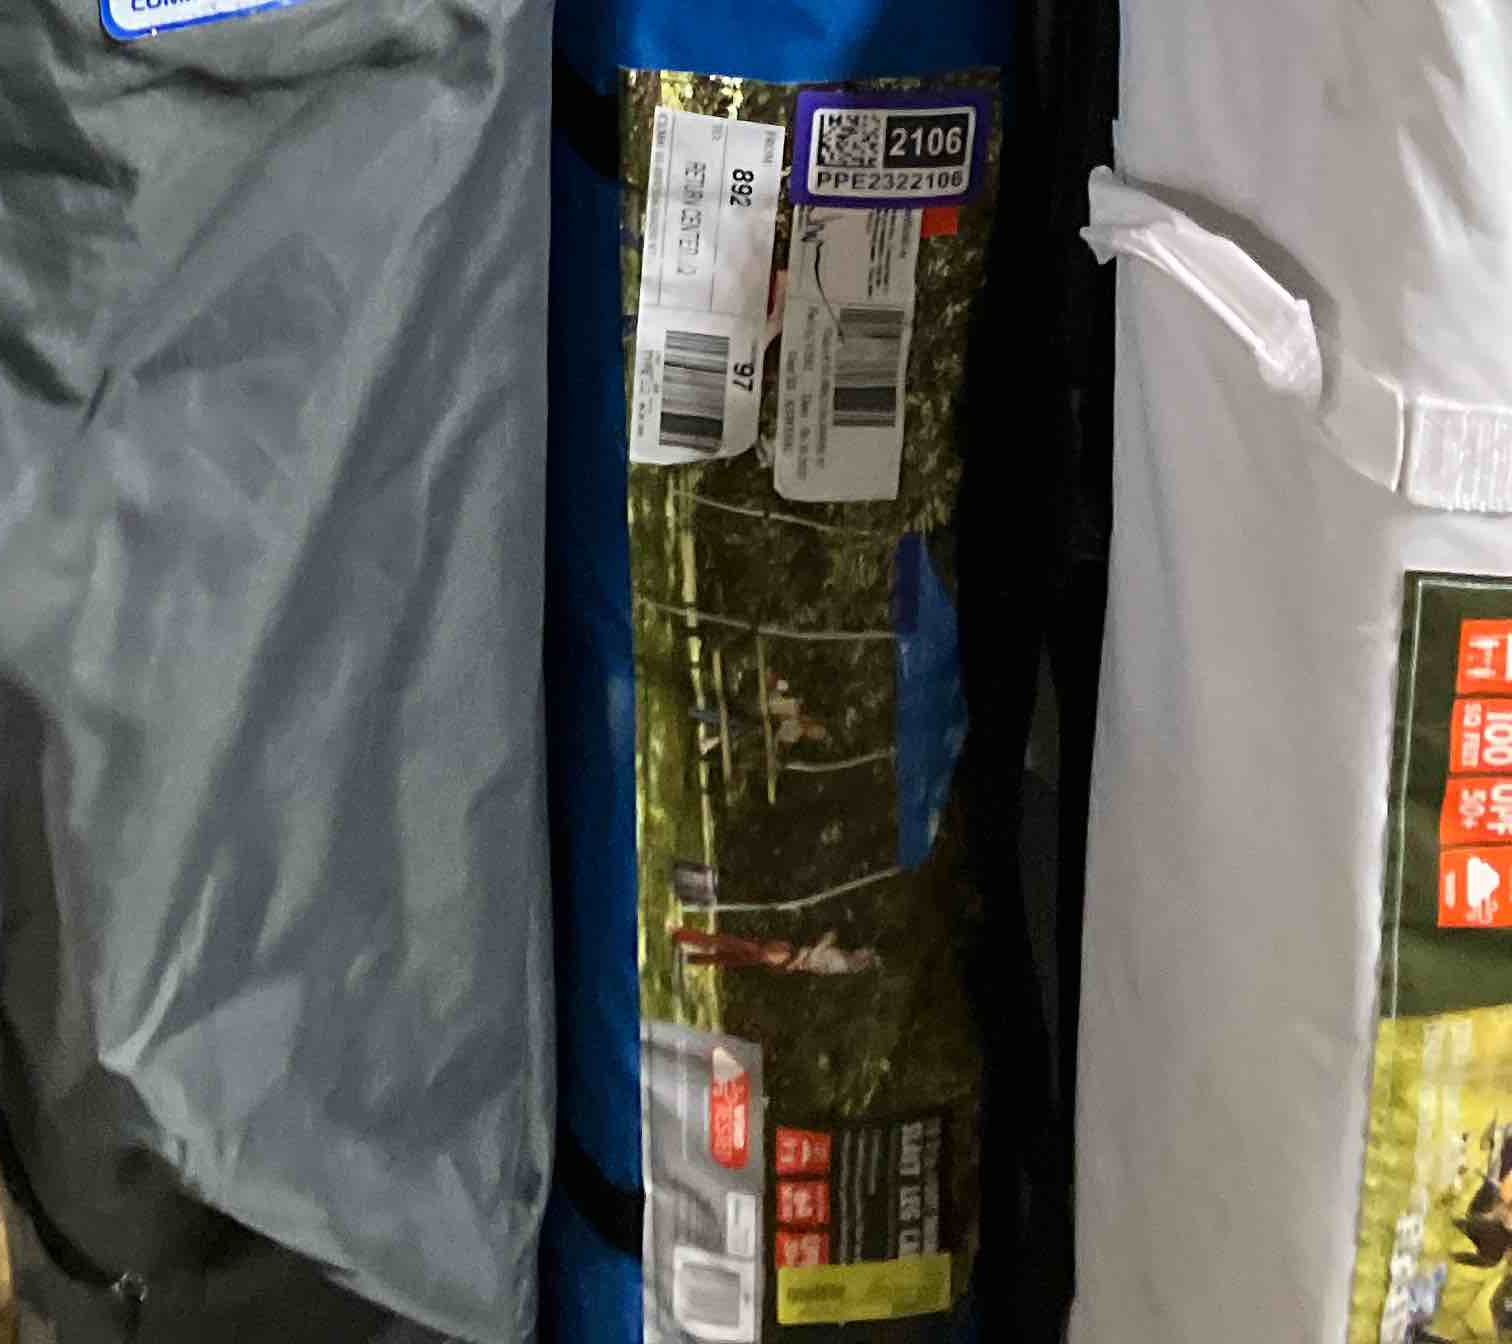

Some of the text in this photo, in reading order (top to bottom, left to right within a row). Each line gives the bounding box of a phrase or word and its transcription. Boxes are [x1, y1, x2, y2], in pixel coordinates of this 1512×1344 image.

[889, 127, 963, 157] 2106
[729, 167, 755, 208] 892
[816, 170, 963, 191] PPE2322106
[732, 361, 755, 391] 97
